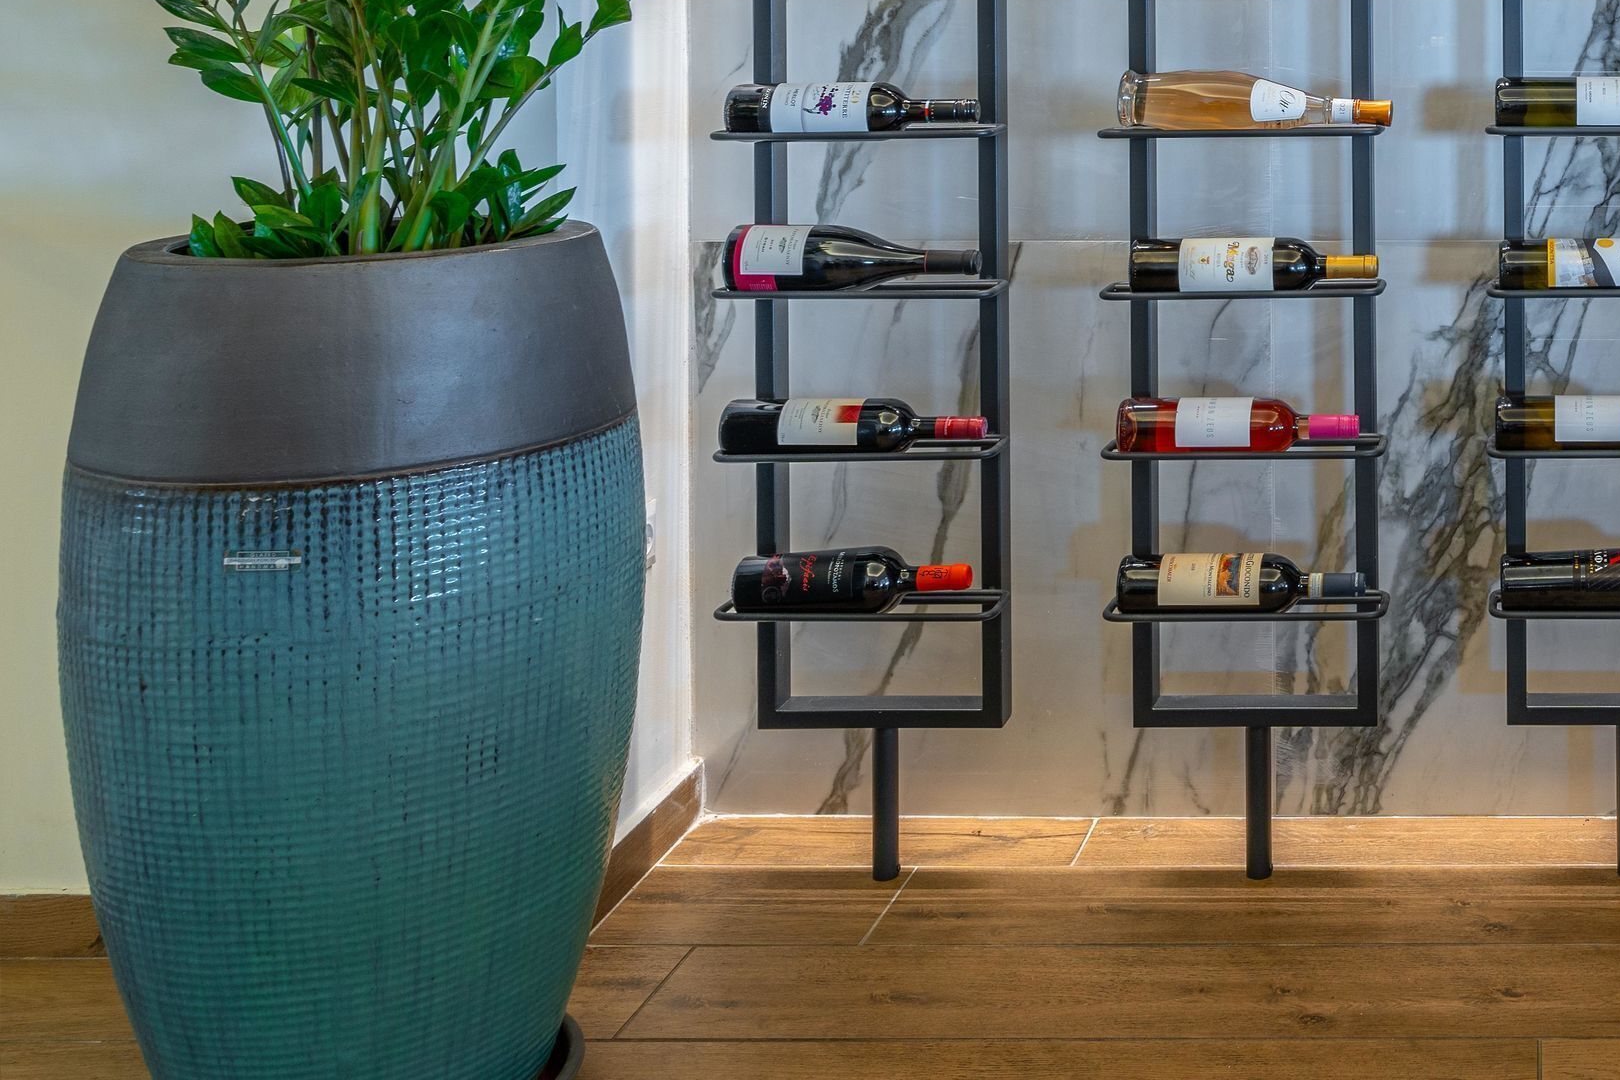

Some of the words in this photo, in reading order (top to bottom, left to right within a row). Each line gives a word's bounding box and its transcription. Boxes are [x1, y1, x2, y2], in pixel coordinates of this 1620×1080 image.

[761, 87, 771, 109] ZONIN
[790, 88, 800, 107] MERLOT
[1224, 241, 1241, 282] Muga
[1206, 417, 1216, 439] ZEUS
[1585, 411, 1594, 432] ZEUS
[1206, 565, 1214, 596] MONTALCINO
